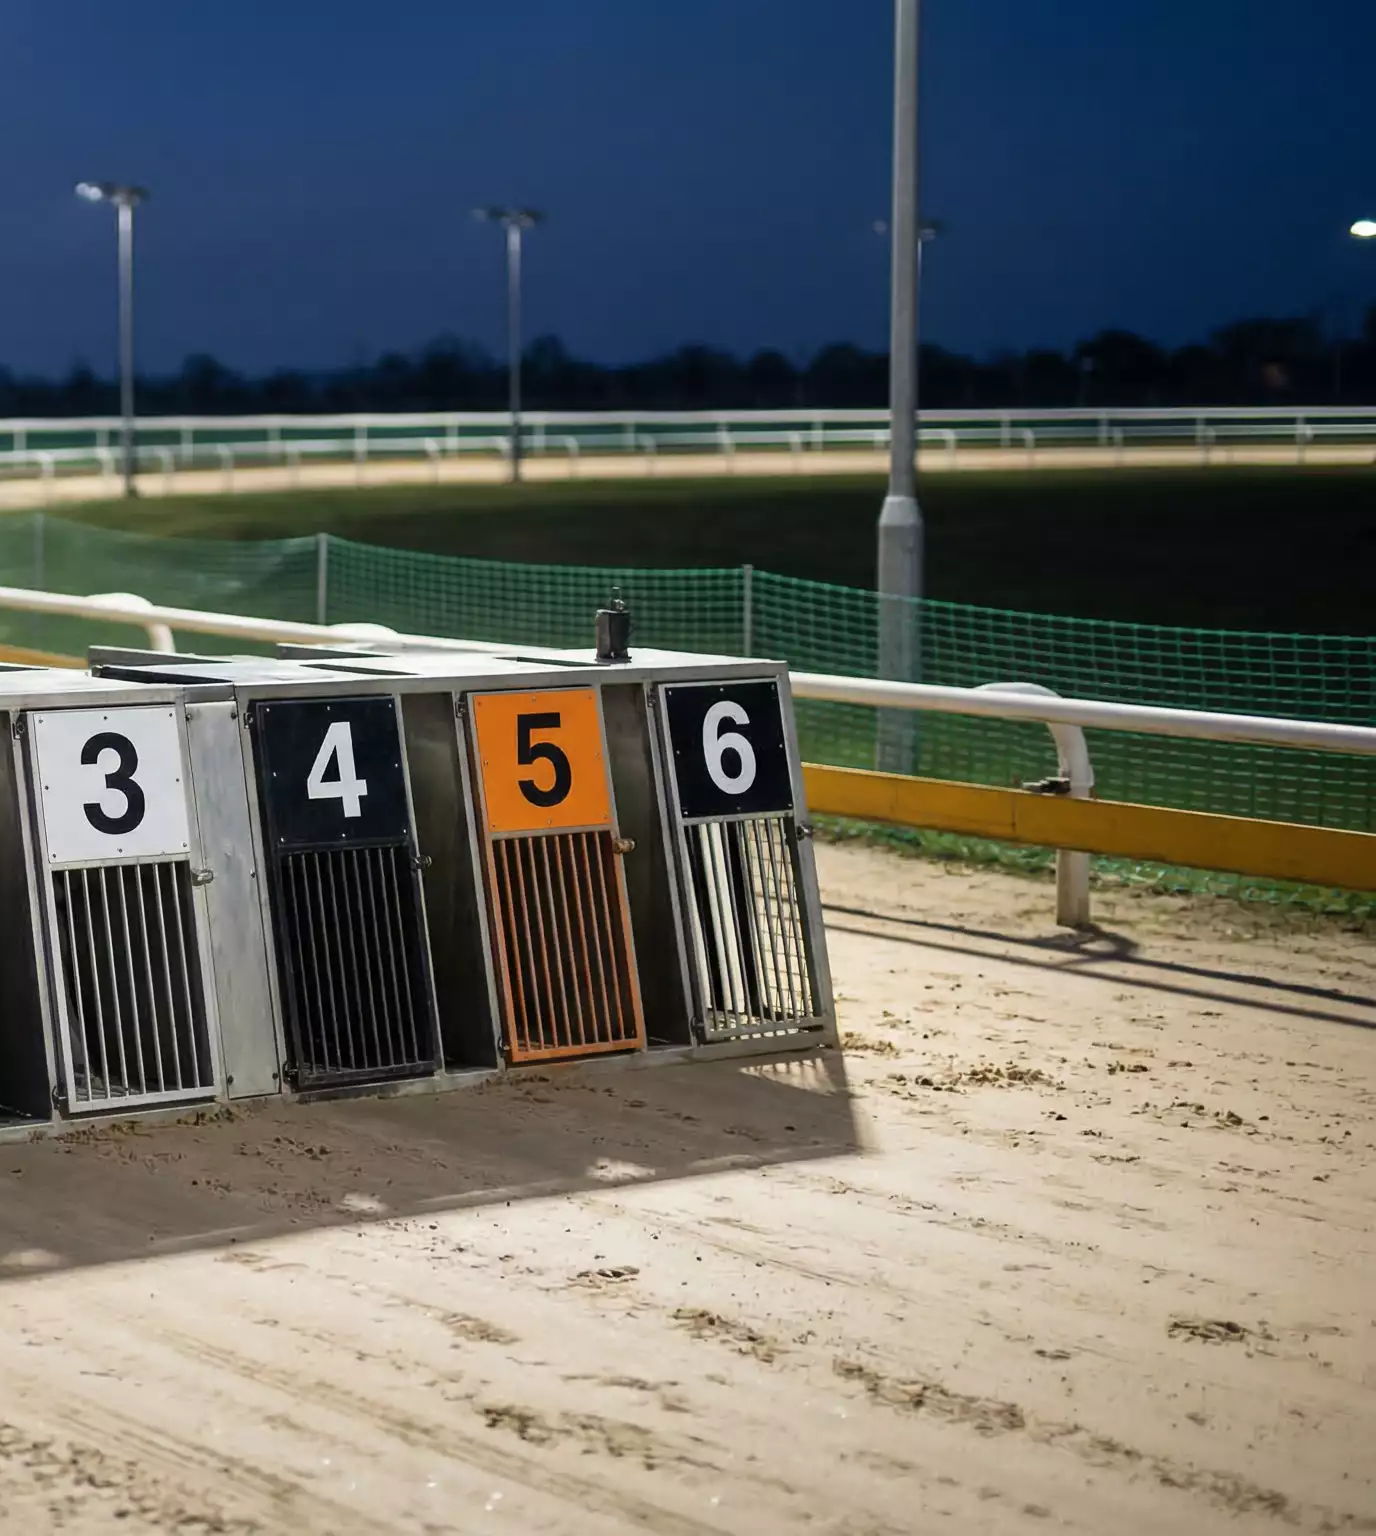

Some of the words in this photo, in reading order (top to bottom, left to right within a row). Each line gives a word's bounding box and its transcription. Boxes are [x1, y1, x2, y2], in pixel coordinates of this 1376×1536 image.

[79, 732, 146, 835] 3
[306, 721, 368, 818] 4
[516, 712, 572, 808] 5
[702, 700, 756, 795] 6
